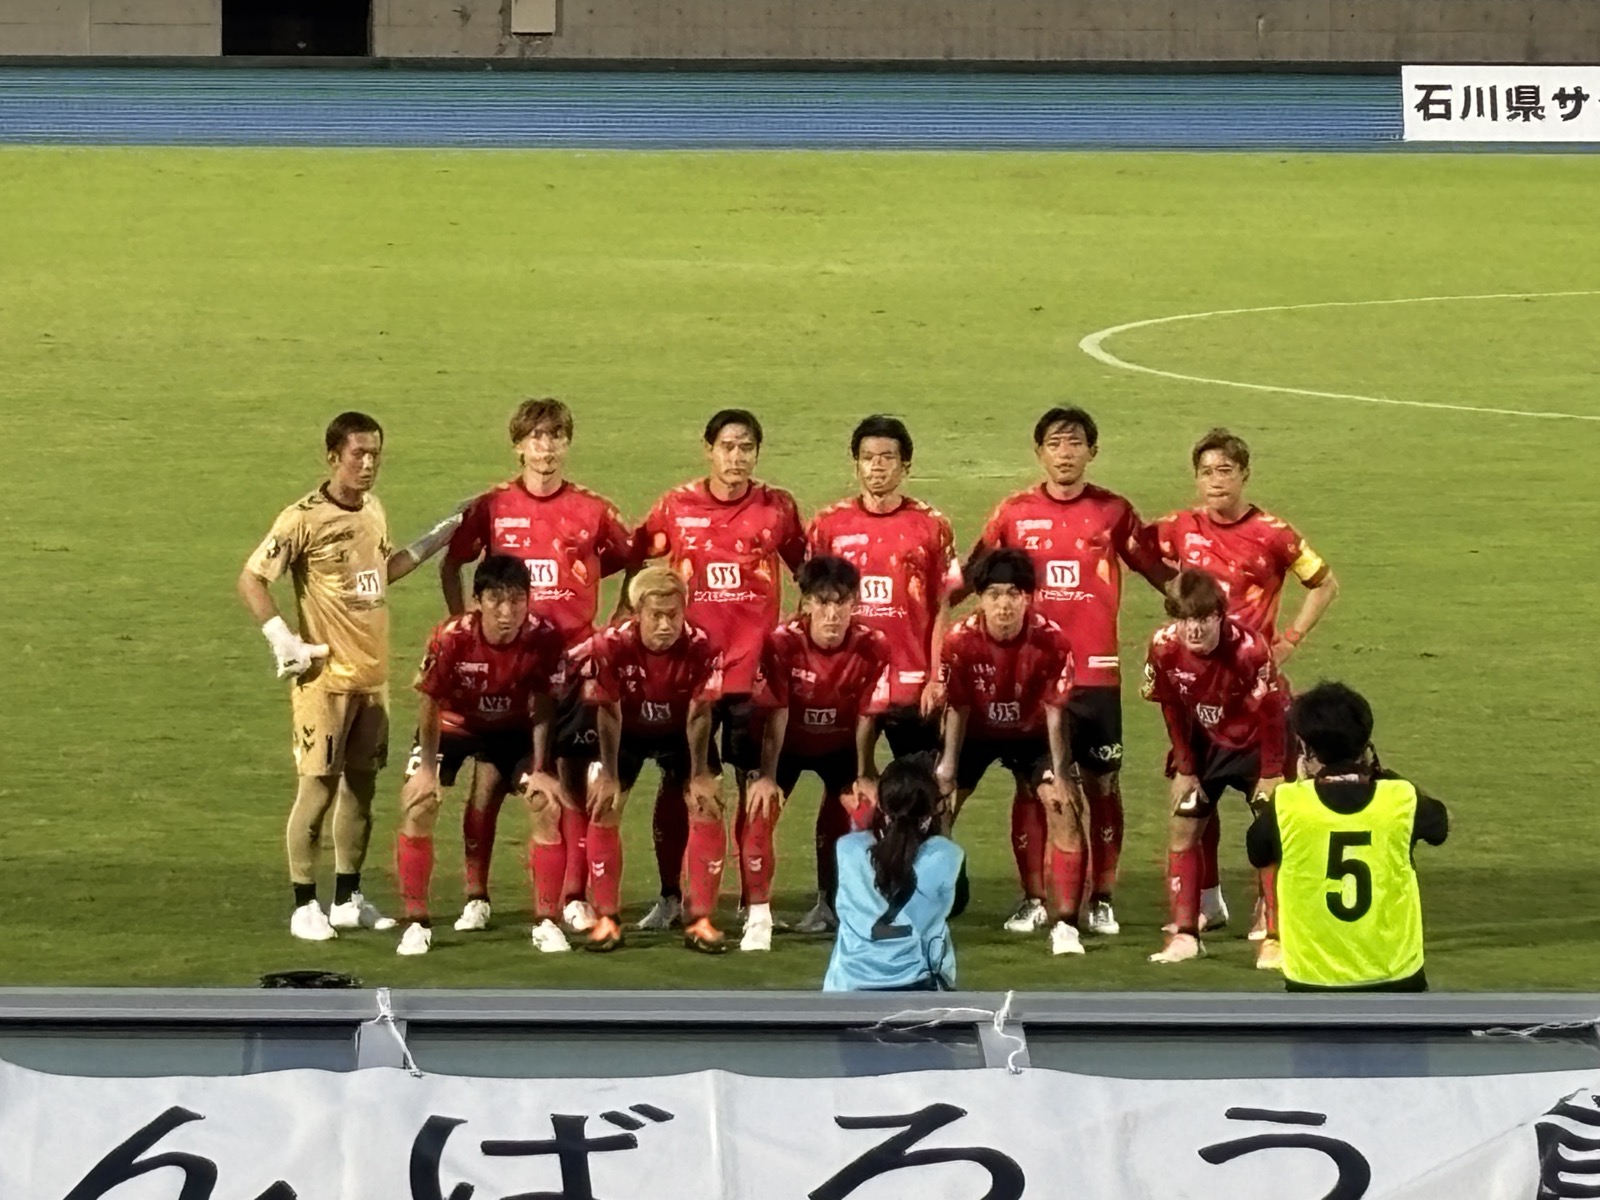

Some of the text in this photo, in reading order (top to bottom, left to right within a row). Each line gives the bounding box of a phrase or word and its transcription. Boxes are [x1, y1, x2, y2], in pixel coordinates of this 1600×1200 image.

[1414, 84, 1600, 122] 石川県サ
[1326, 831, 1372, 922] 5
